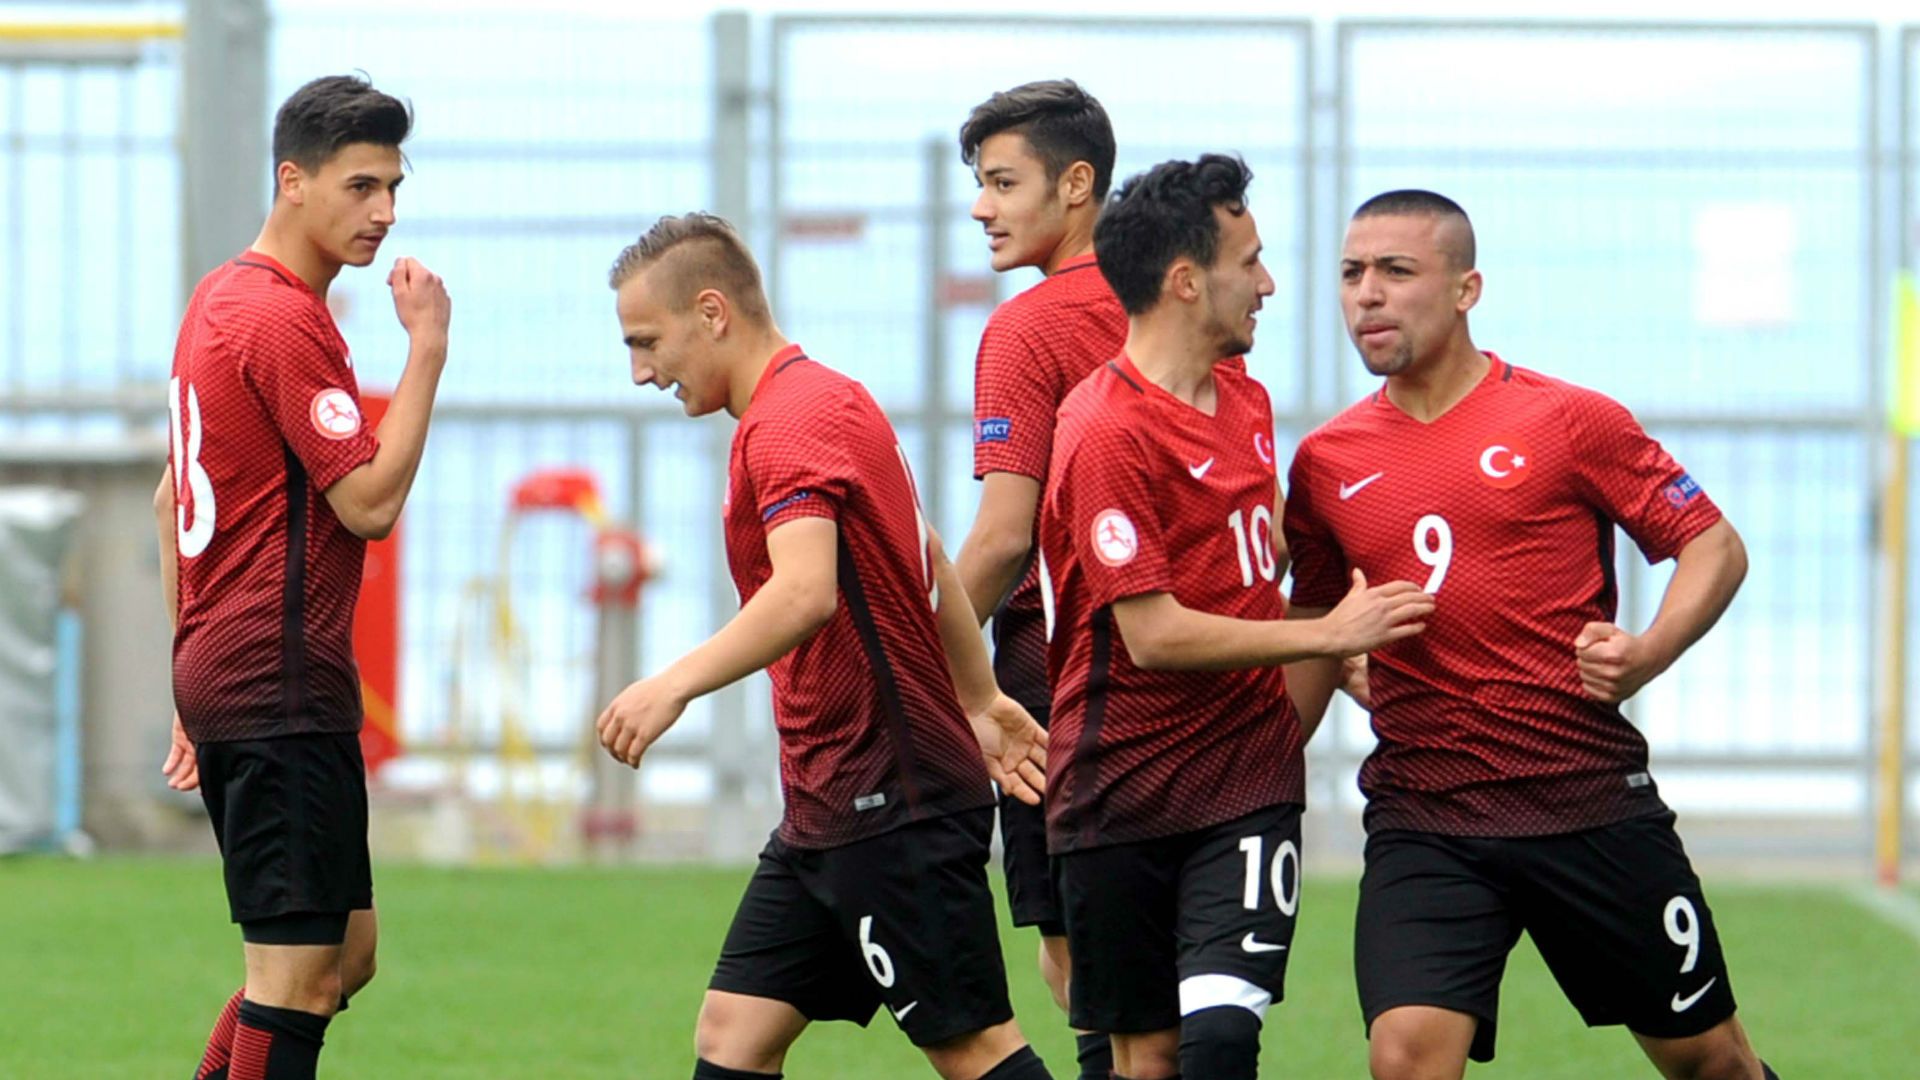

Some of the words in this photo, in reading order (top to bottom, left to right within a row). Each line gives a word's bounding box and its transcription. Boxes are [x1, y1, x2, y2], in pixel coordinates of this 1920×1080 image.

[1228, 504, 1276, 587] 10
[1413, 514, 1453, 594] 9
[1239, 835, 1299, 917] 10
[859, 915, 895, 988] 6
[1663, 895, 1699, 973] 9
